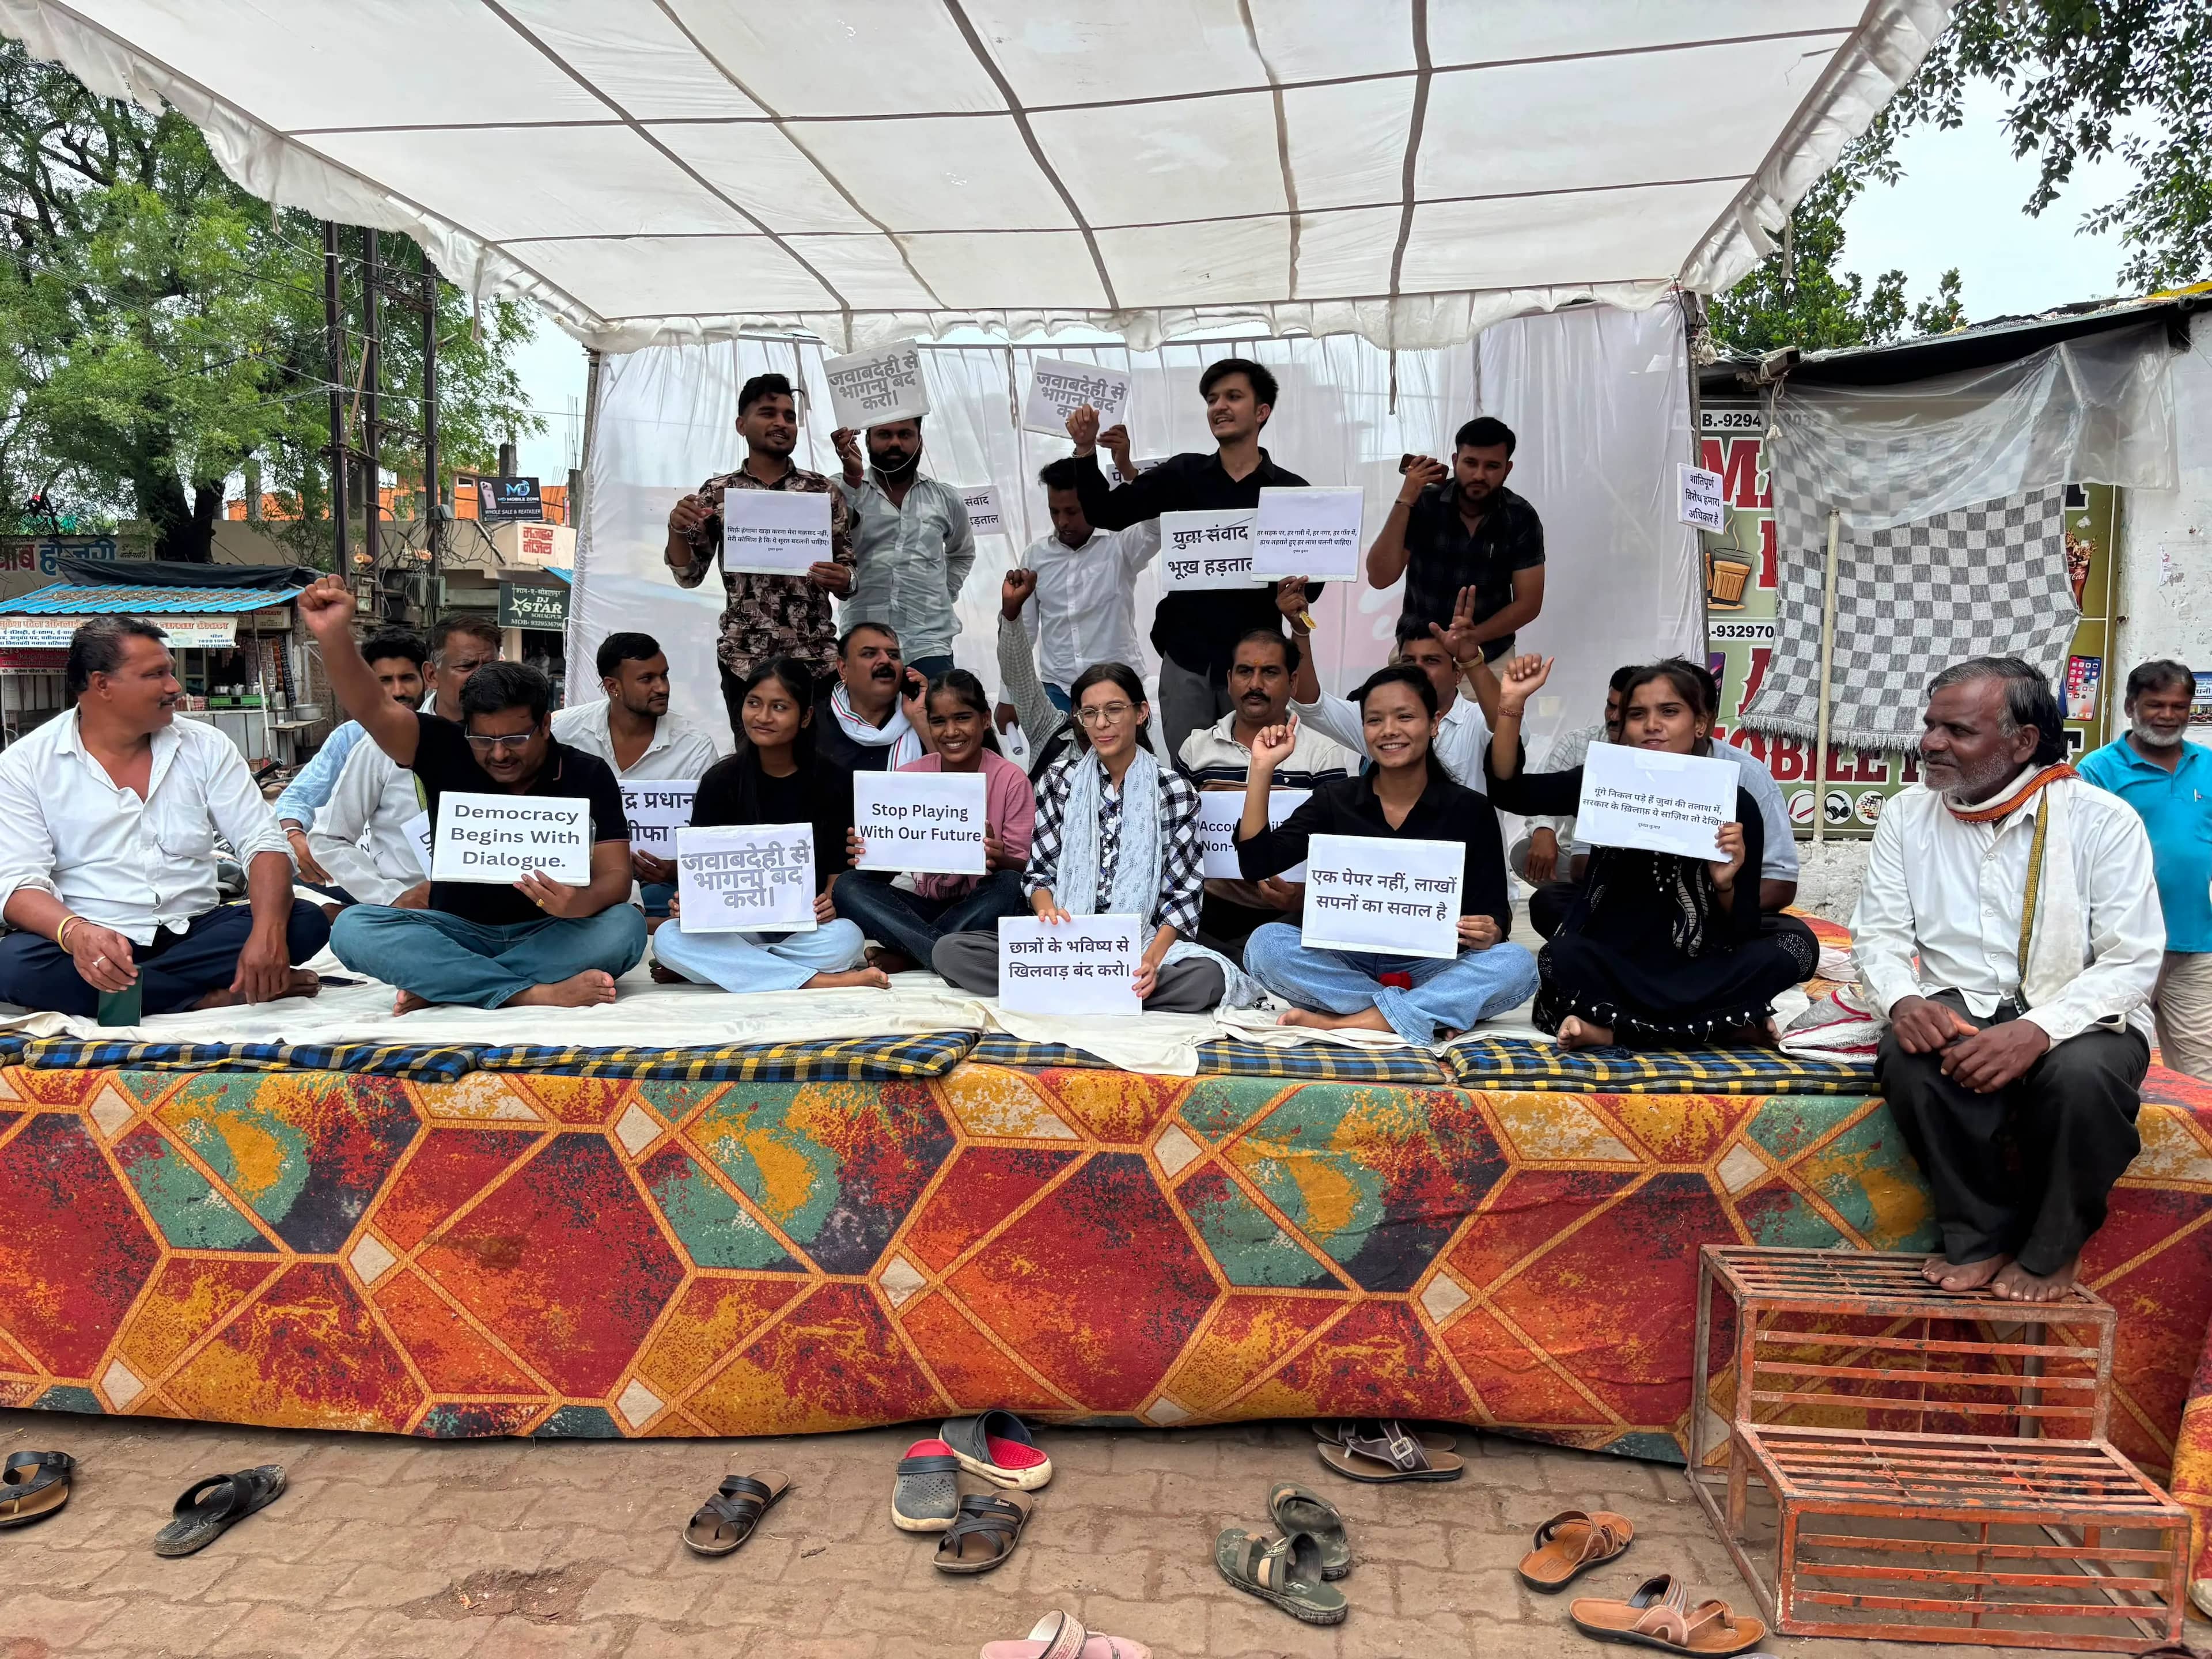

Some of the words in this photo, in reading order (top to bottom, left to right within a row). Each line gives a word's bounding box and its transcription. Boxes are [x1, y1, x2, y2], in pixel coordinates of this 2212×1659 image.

[828, 354, 900, 385] जवाबदेही
[903, 350, 918, 369] से
[1036, 372, 1108, 397] जवाबदेही
[1111, 382, 1127, 400] से
[1690, 473, 1714, 490] शांतिपूर्ण
[964, 495, 989, 506] संवाद
[1685, 488, 1702, 503] विरोध
[1703, 495, 1719, 507] हमारा
[1688, 507, 1713, 523] अधिकार
[1714, 512, 1719, 525] है
[1173, 530, 1202, 550] युवा
[1206, 524, 1249, 542] संवाद
[522, 601, 562, 614] STAR
[1608, 788, 1633, 800] निकल
[1634, 793, 1646, 804] पड़े
[1675, 799, 1686, 808] की
[1688, 802, 1711, 812] तलाश
[455, 804, 579, 825] Democracy
[872, 803, 907, 820] Stop
[912, 804, 968, 822] Playing
[1582, 798, 1609, 809] सरकार
[1611, 801, 1619, 810] के
[1652, 808, 1658, 816] ये
[1691, 814, 1700, 823] तो
[451, 828, 524, 845] Begins
[531, 830, 579, 844] With
[860, 825, 893, 839] With
[899, 827, 926, 840] Our
[931, 828, 981, 842] Future
[463, 851, 566, 870] Dialogue.
[681, 841, 785, 871] जवाबदेही
[789, 839, 810, 863] से
[1312, 869, 1338, 885] एक
[1342, 868, 1373, 887] पेपर
[1377, 873, 1409, 893] नहीं,
[1414, 877, 1457, 894] लाखों
[1316, 894, 1359, 911] सपनों
[1362, 900, 1383, 913] का
[1387, 902, 1433, 917] सवाल
[1436, 902, 1448, 921] है
[1009, 937, 1044, 953] छात्रों
[1047, 937, 1062, 953] के
[1067, 937, 1112, 952] भविष्य
[1116, 936, 1129, 952] से
[1009, 961, 1069, 980] खिलवाड़
[1073, 961, 1093, 977] बंद
[1097, 960, 1130, 977] करो।
